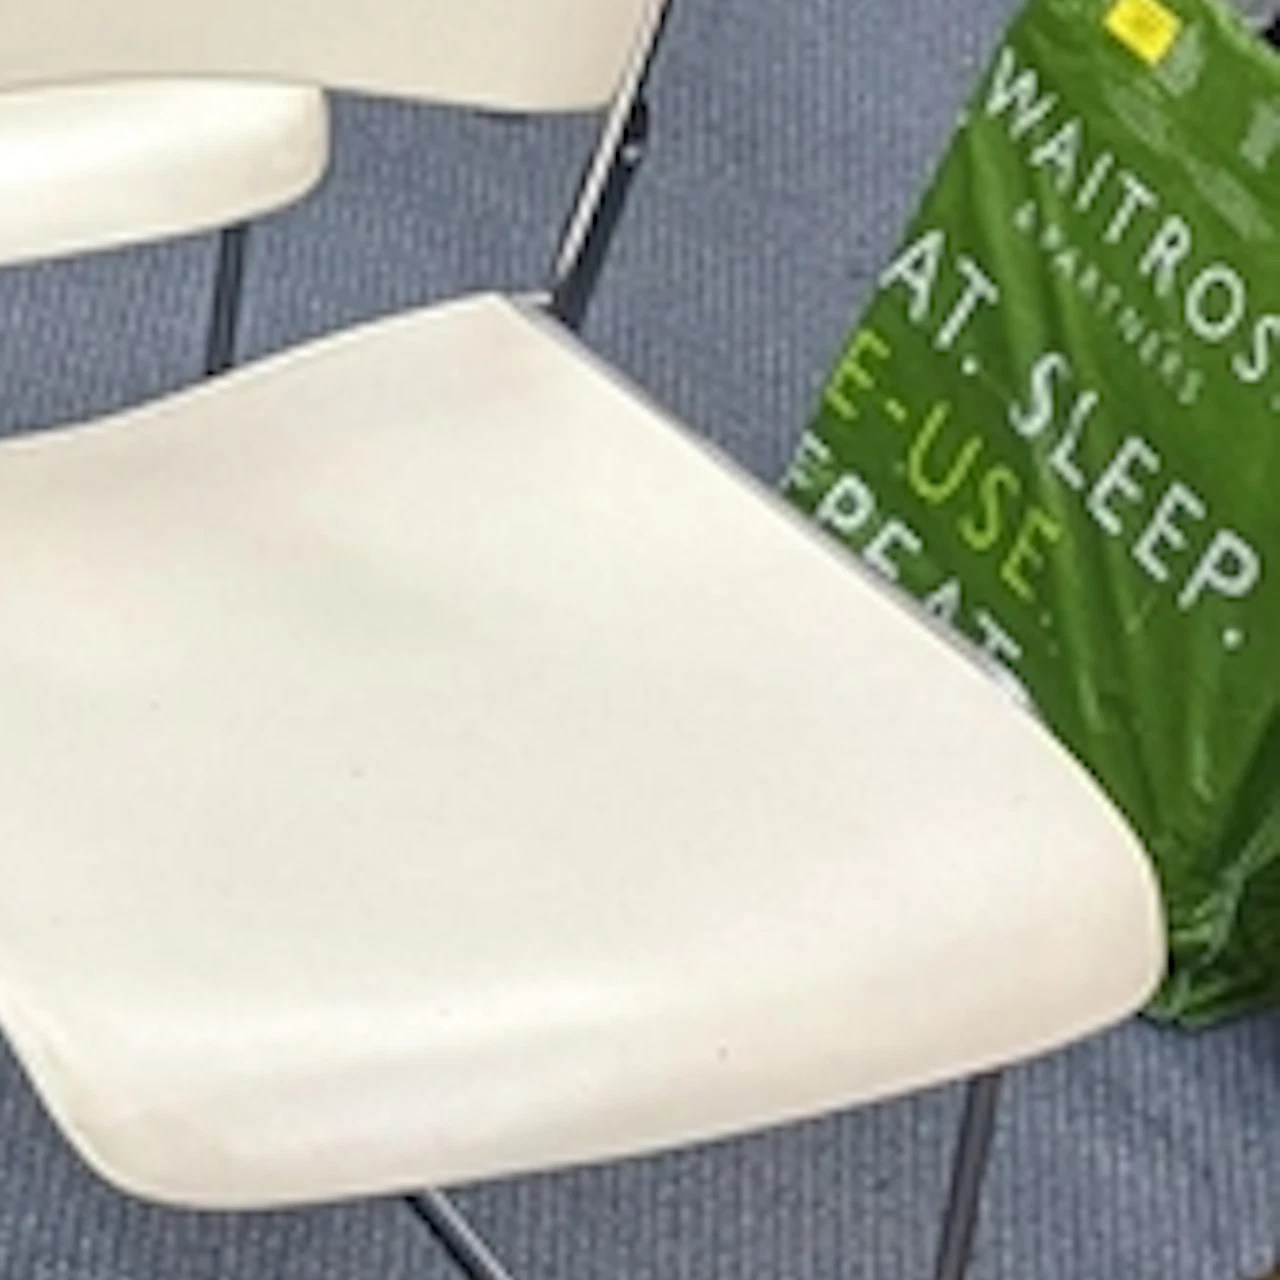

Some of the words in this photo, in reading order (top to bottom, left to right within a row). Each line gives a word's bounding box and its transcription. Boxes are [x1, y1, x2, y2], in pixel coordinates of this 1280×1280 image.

[986, 45, 1280, 412] WAITROS
[825, 329, 1062, 628] E-USE.
[878, 229, 1000, 376] AT.
[1007, 351, 1261, 649] SLEEP.
